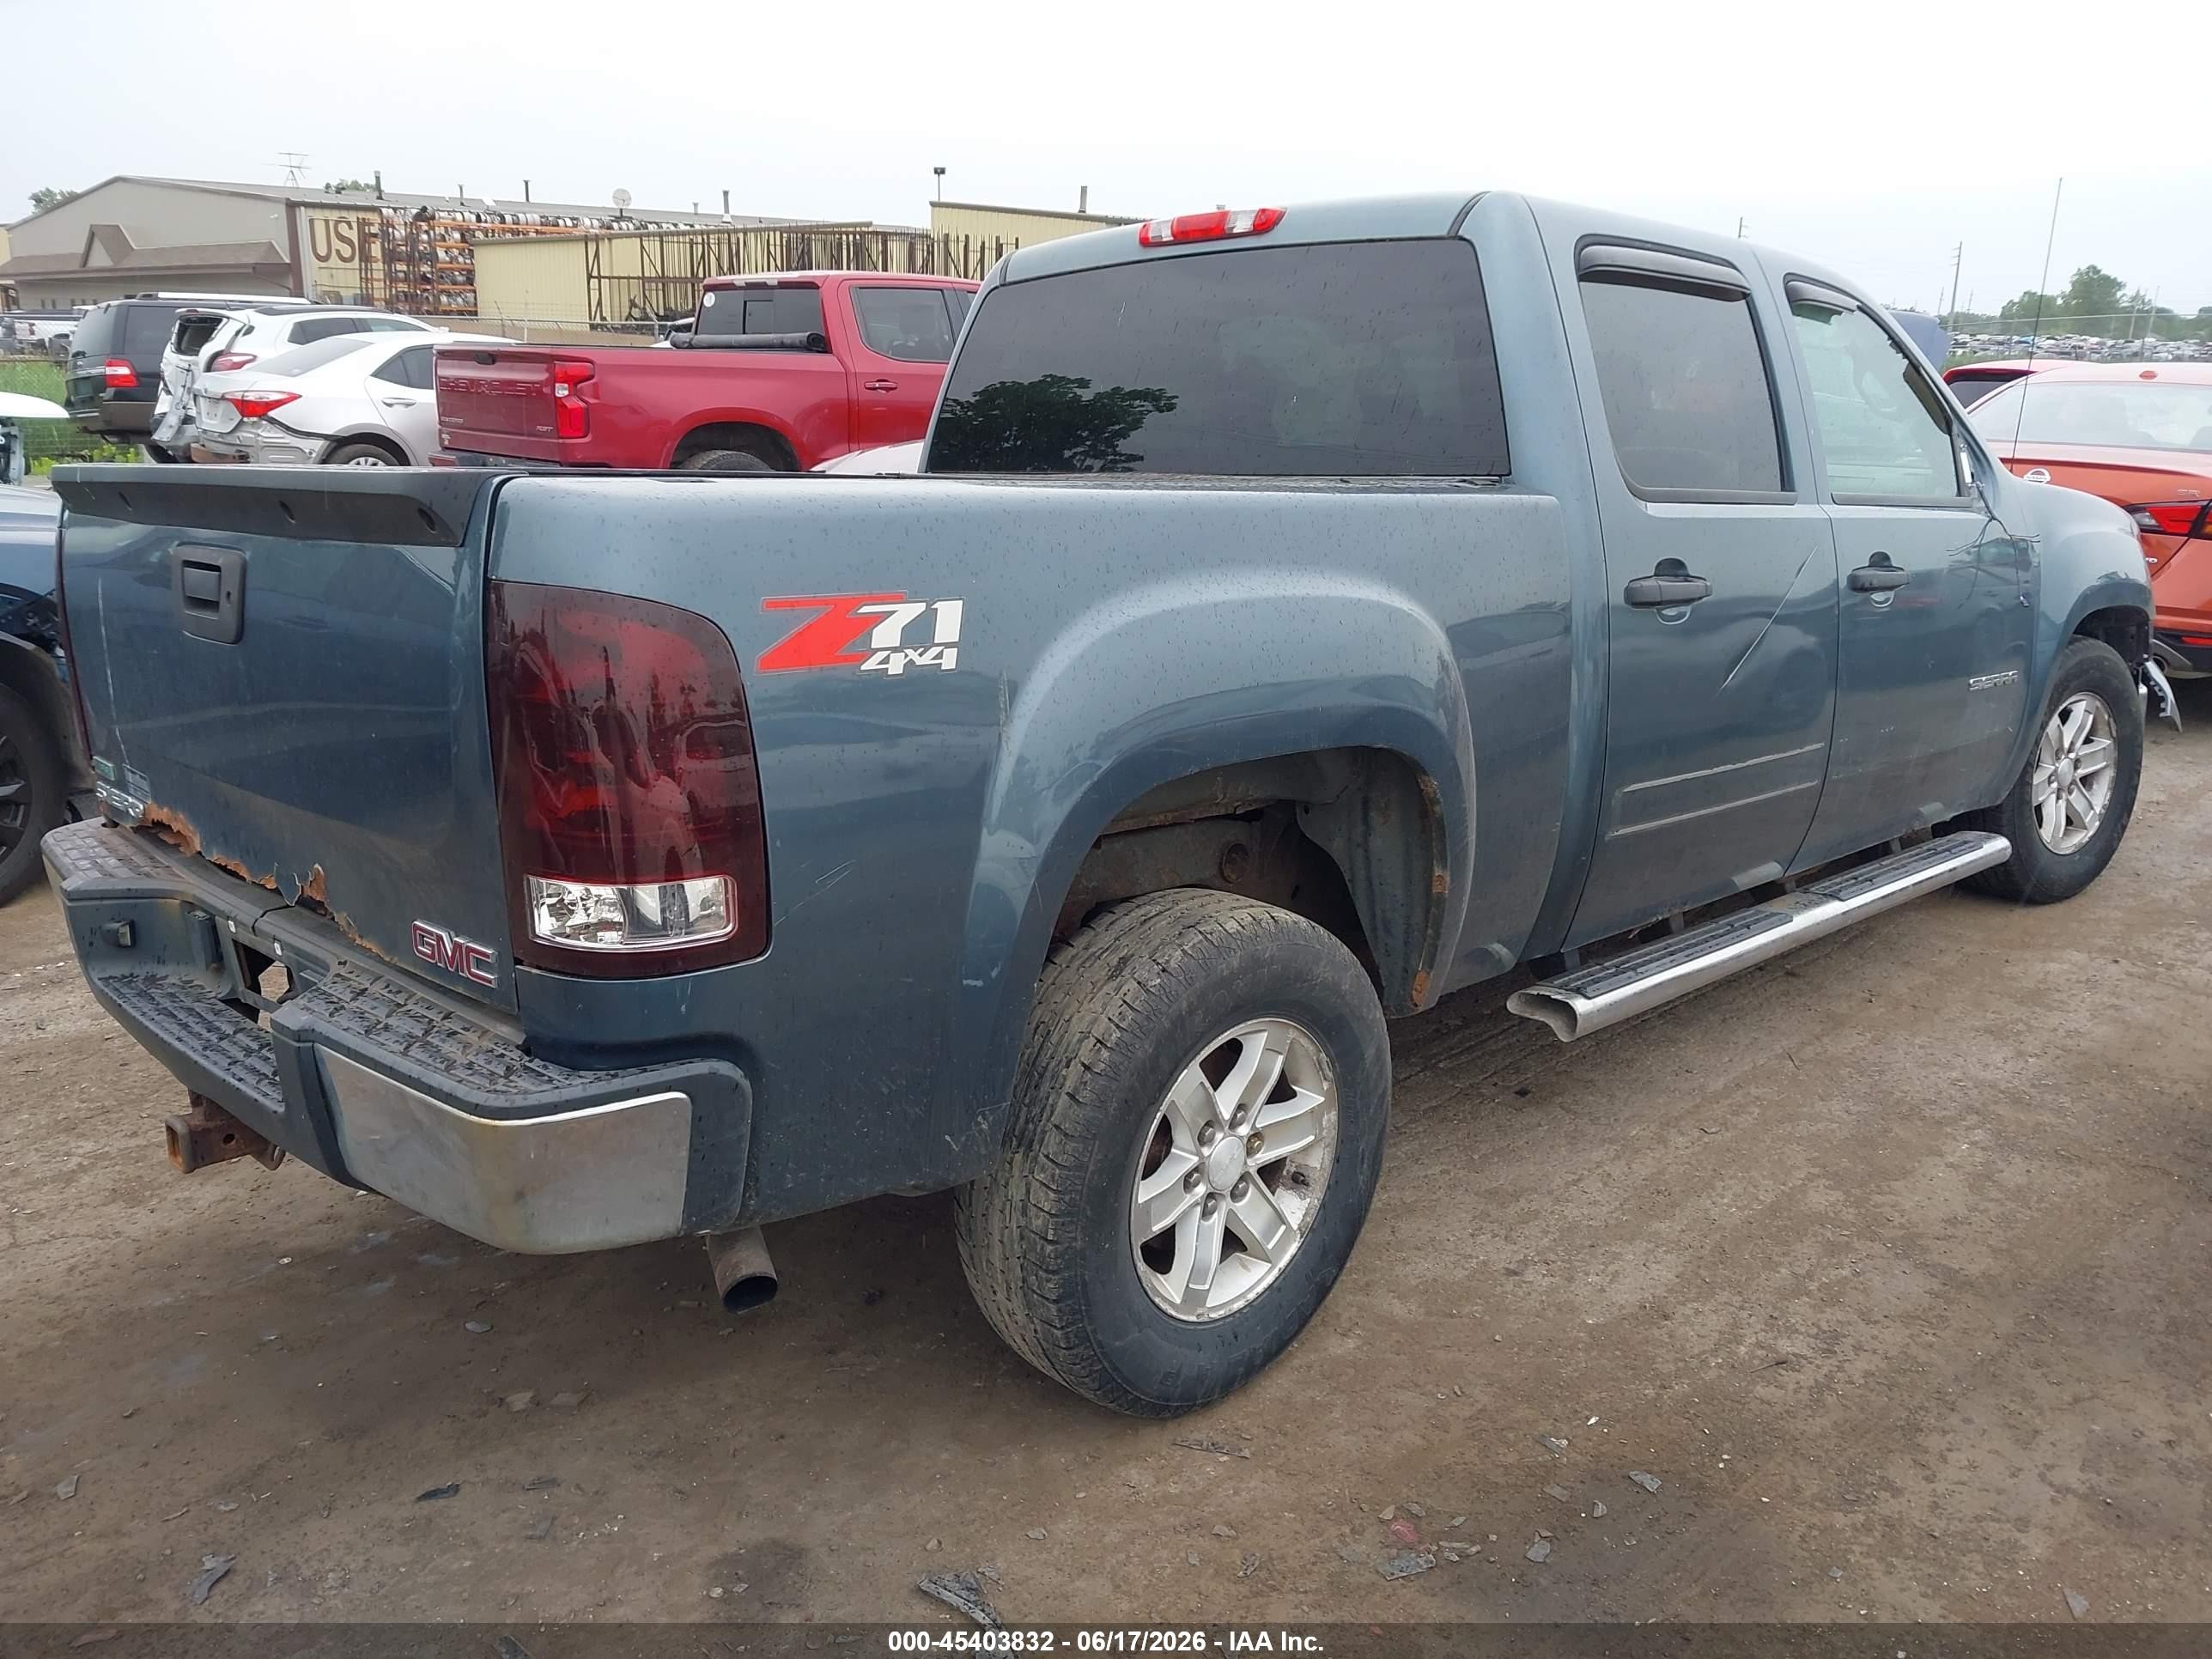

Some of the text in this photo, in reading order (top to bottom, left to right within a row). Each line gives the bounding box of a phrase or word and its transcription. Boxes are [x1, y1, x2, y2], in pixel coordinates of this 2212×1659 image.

[758, 592, 963, 672] Z71
[1968, 669, 2019, 691] SIERRA
[412, 919, 498, 988] GMC
